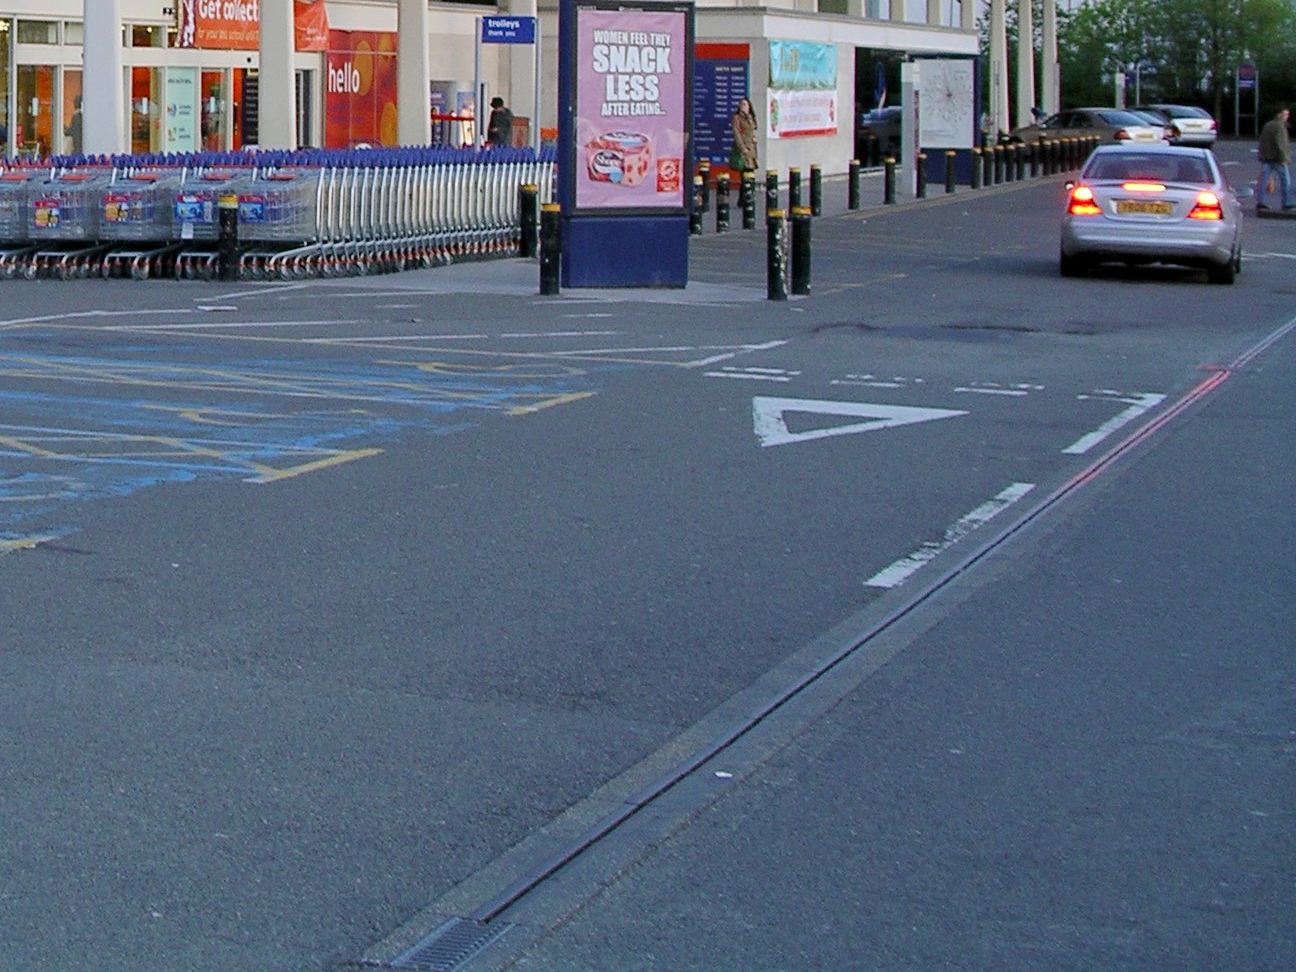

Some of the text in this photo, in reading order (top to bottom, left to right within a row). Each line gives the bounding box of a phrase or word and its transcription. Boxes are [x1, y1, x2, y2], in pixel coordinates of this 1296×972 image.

[488, 18, 521, 30] trolleys
[593, 29, 671, 47] WOMEN FEEL THEY
[592, 44, 672, 74] SNACK
[327, 62, 360, 94] hello
[605, 74, 660, 102] LESS
[601, 102, 630, 117] AFTER
